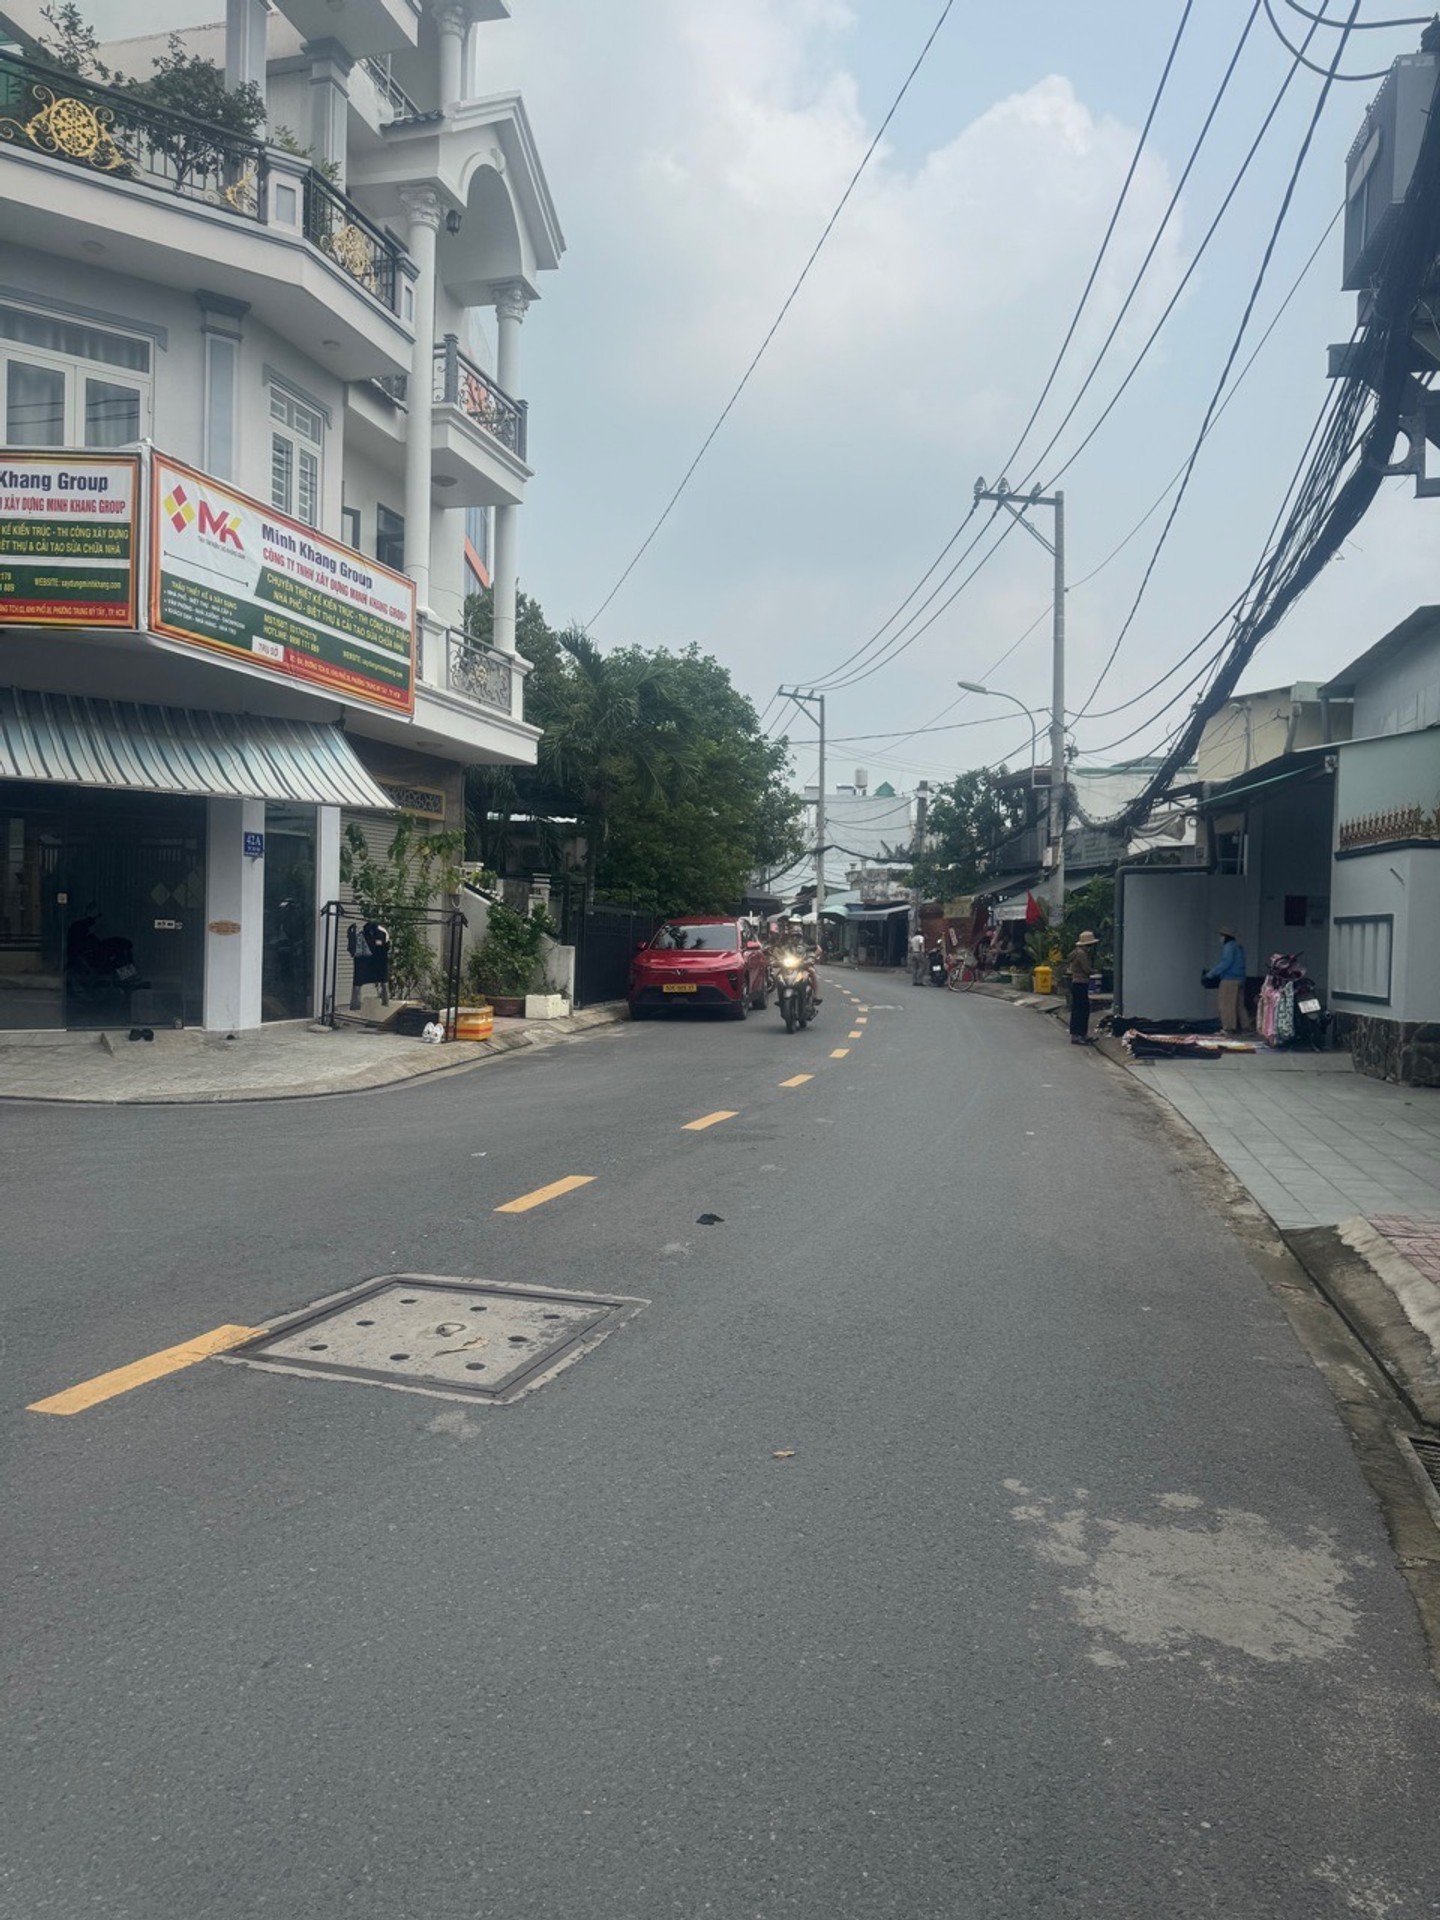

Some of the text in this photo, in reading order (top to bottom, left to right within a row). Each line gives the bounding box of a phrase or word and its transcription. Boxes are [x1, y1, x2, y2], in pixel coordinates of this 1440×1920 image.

[0, 471, 108, 492] Khang Group
[4, 494, 20, 511] XÂY
[46, 498, 68, 512] MINH
[70, 498, 97, 513] KHANG
[98, 499, 126, 514] GROUP
[262, 524, 296, 553] Minh
[299, 543, 337, 574] Khang
[340, 562, 372, 590] Group
[263, 547, 286, 567] CÔNG
[288, 558, 295, 571] TY
[315, 572, 329, 587] XÂY
